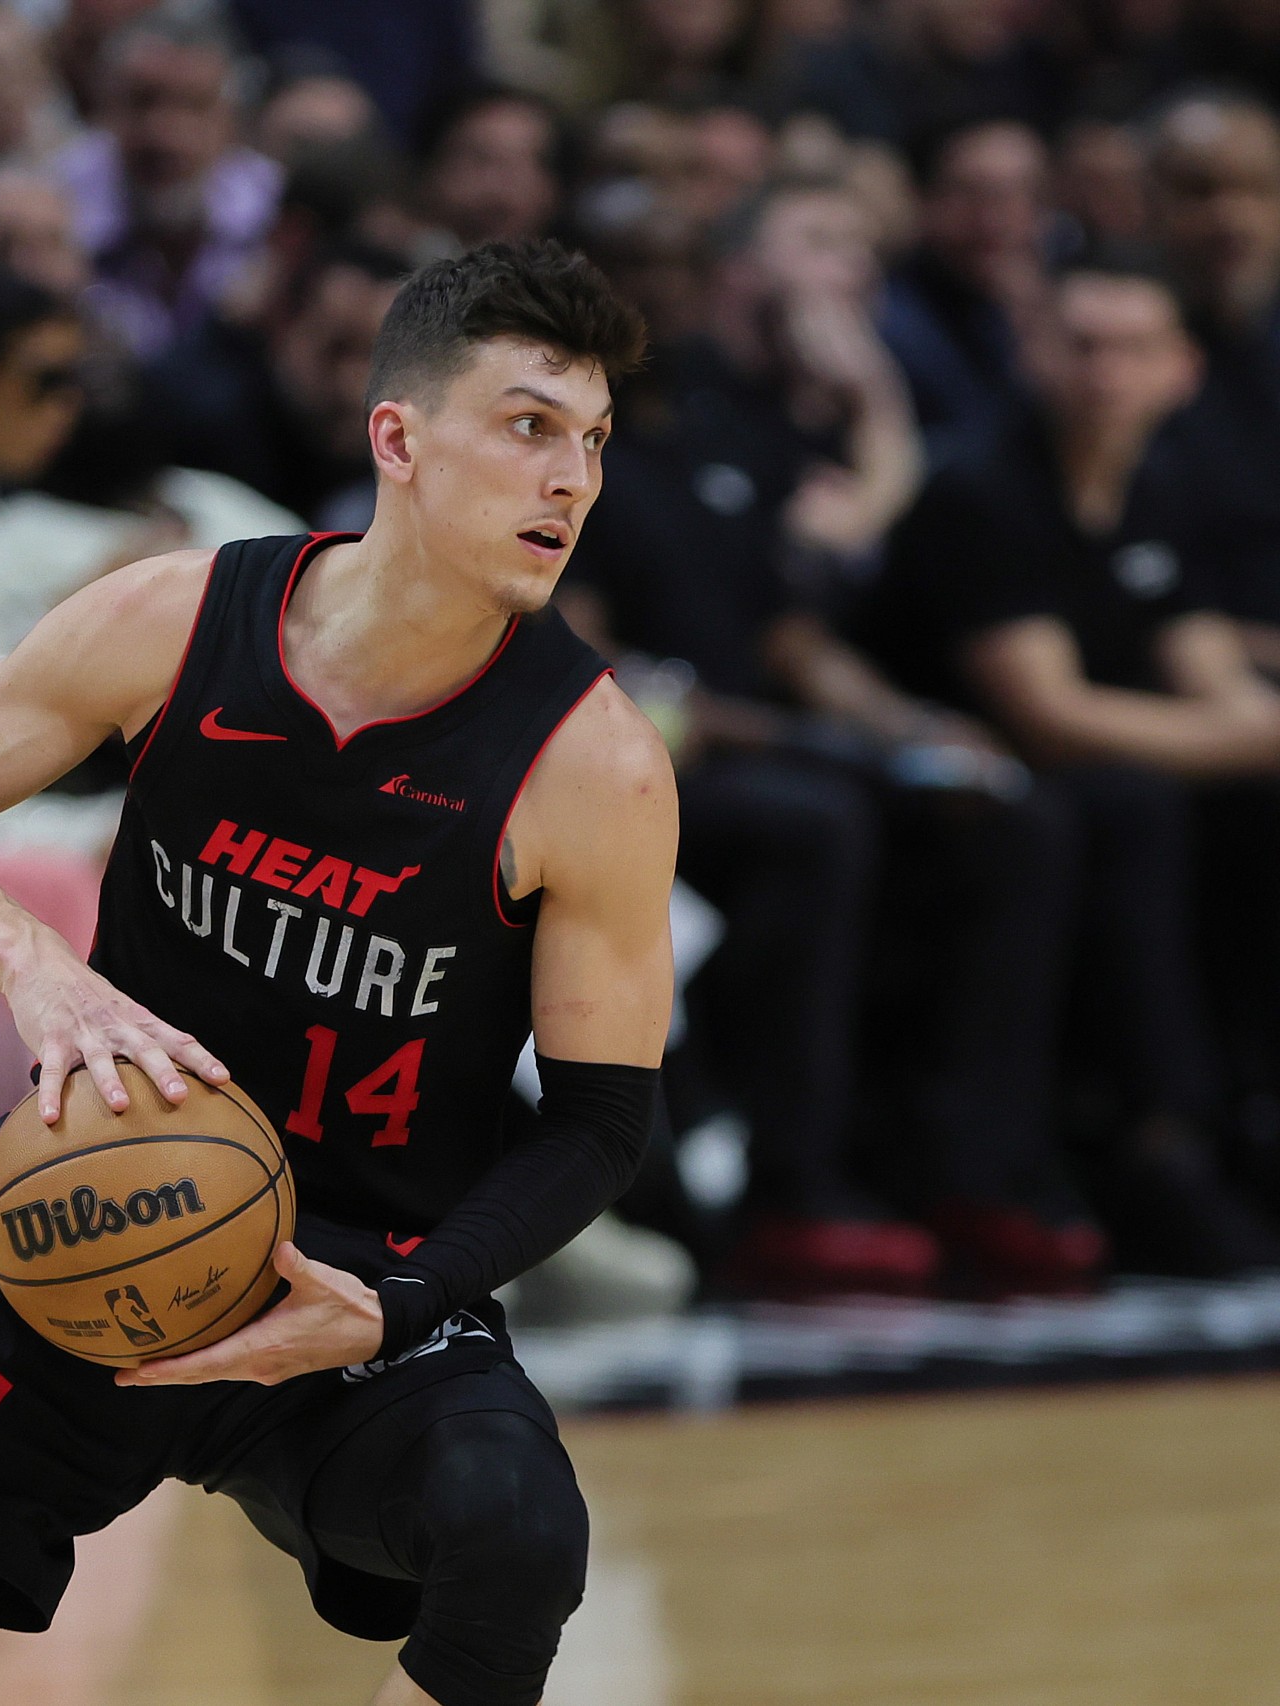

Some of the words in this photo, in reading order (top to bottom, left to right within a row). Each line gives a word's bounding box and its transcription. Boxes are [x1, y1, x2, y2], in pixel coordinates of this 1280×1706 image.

[399, 785, 465, 812] Carnival
[198, 818, 420, 917] HEAT
[151, 839, 456, 1017] CULTURE
[285, 1023, 427, 1147] 14
[0, 1177, 206, 1262] Wilson
